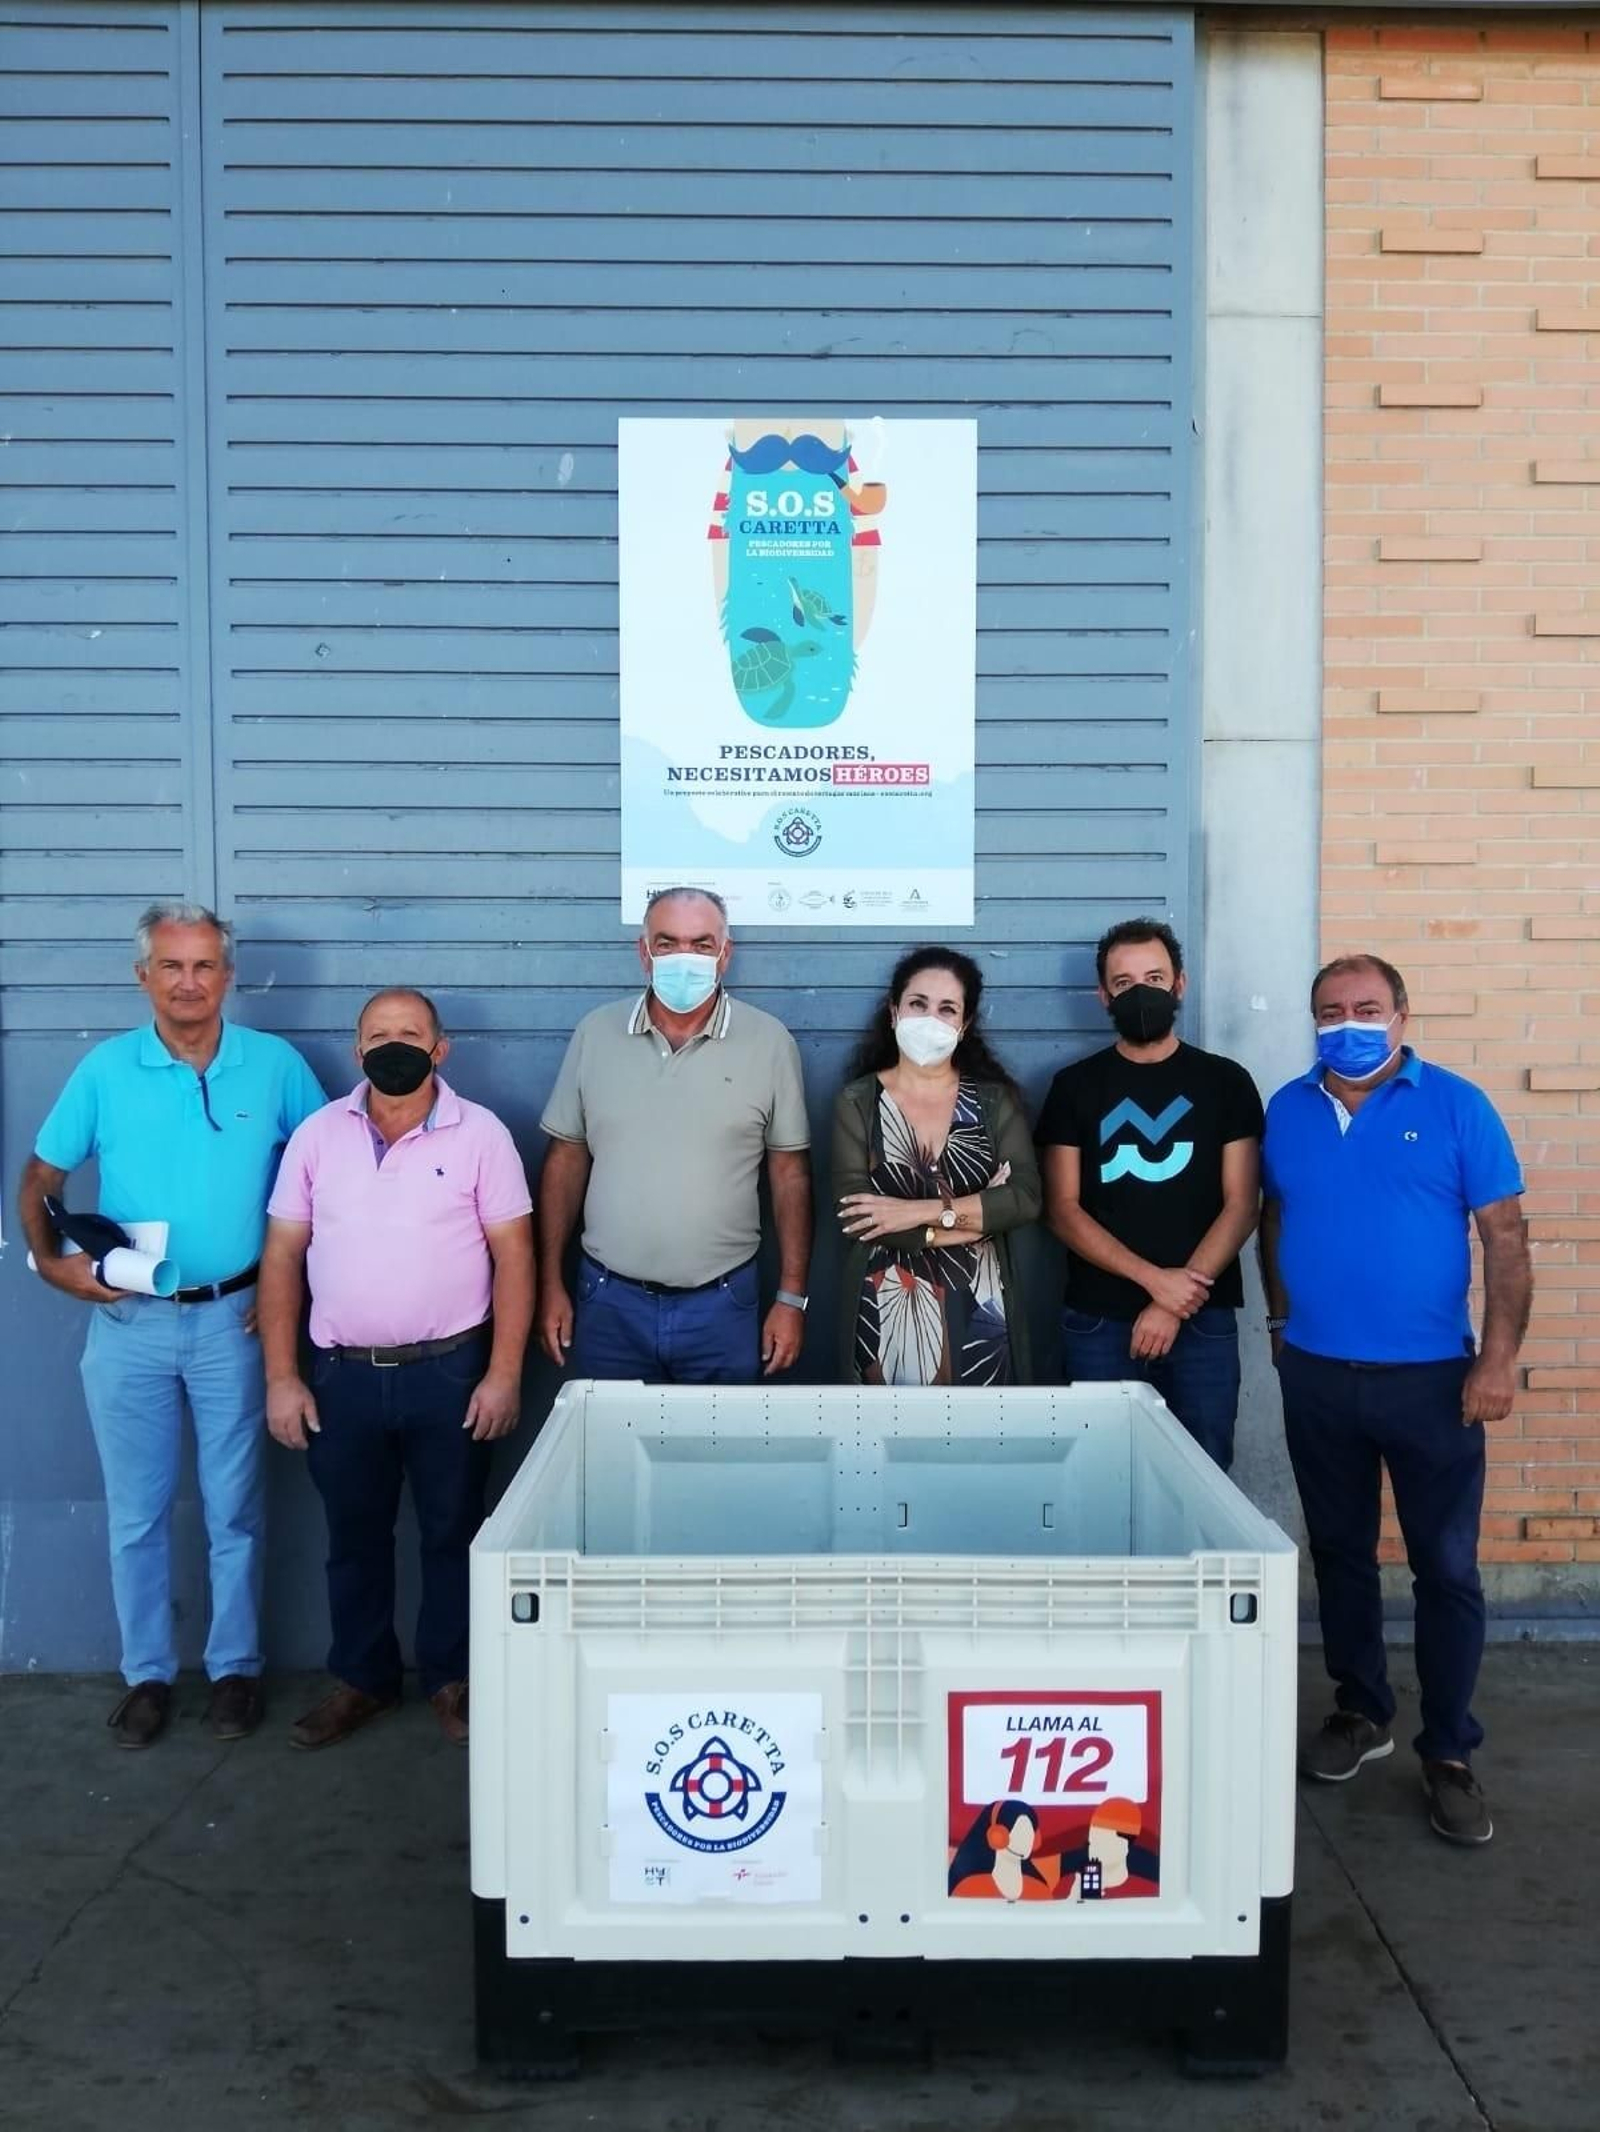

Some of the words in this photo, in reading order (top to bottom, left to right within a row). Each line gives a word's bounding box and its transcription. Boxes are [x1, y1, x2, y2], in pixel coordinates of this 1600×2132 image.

[746, 490, 835, 517] S.O.S
[739, 520, 841, 535] CARETTA
[748, 540, 811, 548] PESCADORES
[811, 540, 832, 548] POR
[746, 549, 758, 557] LA
[759, 549, 835, 557] BIODIVERSIDAD
[718, 745, 875, 761] PESCADORES,
[667, 767, 832, 781] NECESITAMOS
[835, 764, 929, 783] HÉROES
[1006, 1716, 1074, 1732] LLAMA
[1077, 1716, 1104, 1732] AL
[646, 1723, 685, 1776] S.O.S
[687, 1710, 786, 1777] CARETTA
[1000, 1736, 1114, 1793] 112
[651, 1801, 694, 1846] PESCADORES
[694, 1841, 712, 1850] POR
[727, 1800, 780, 1850] BIODIVERSIDAD
